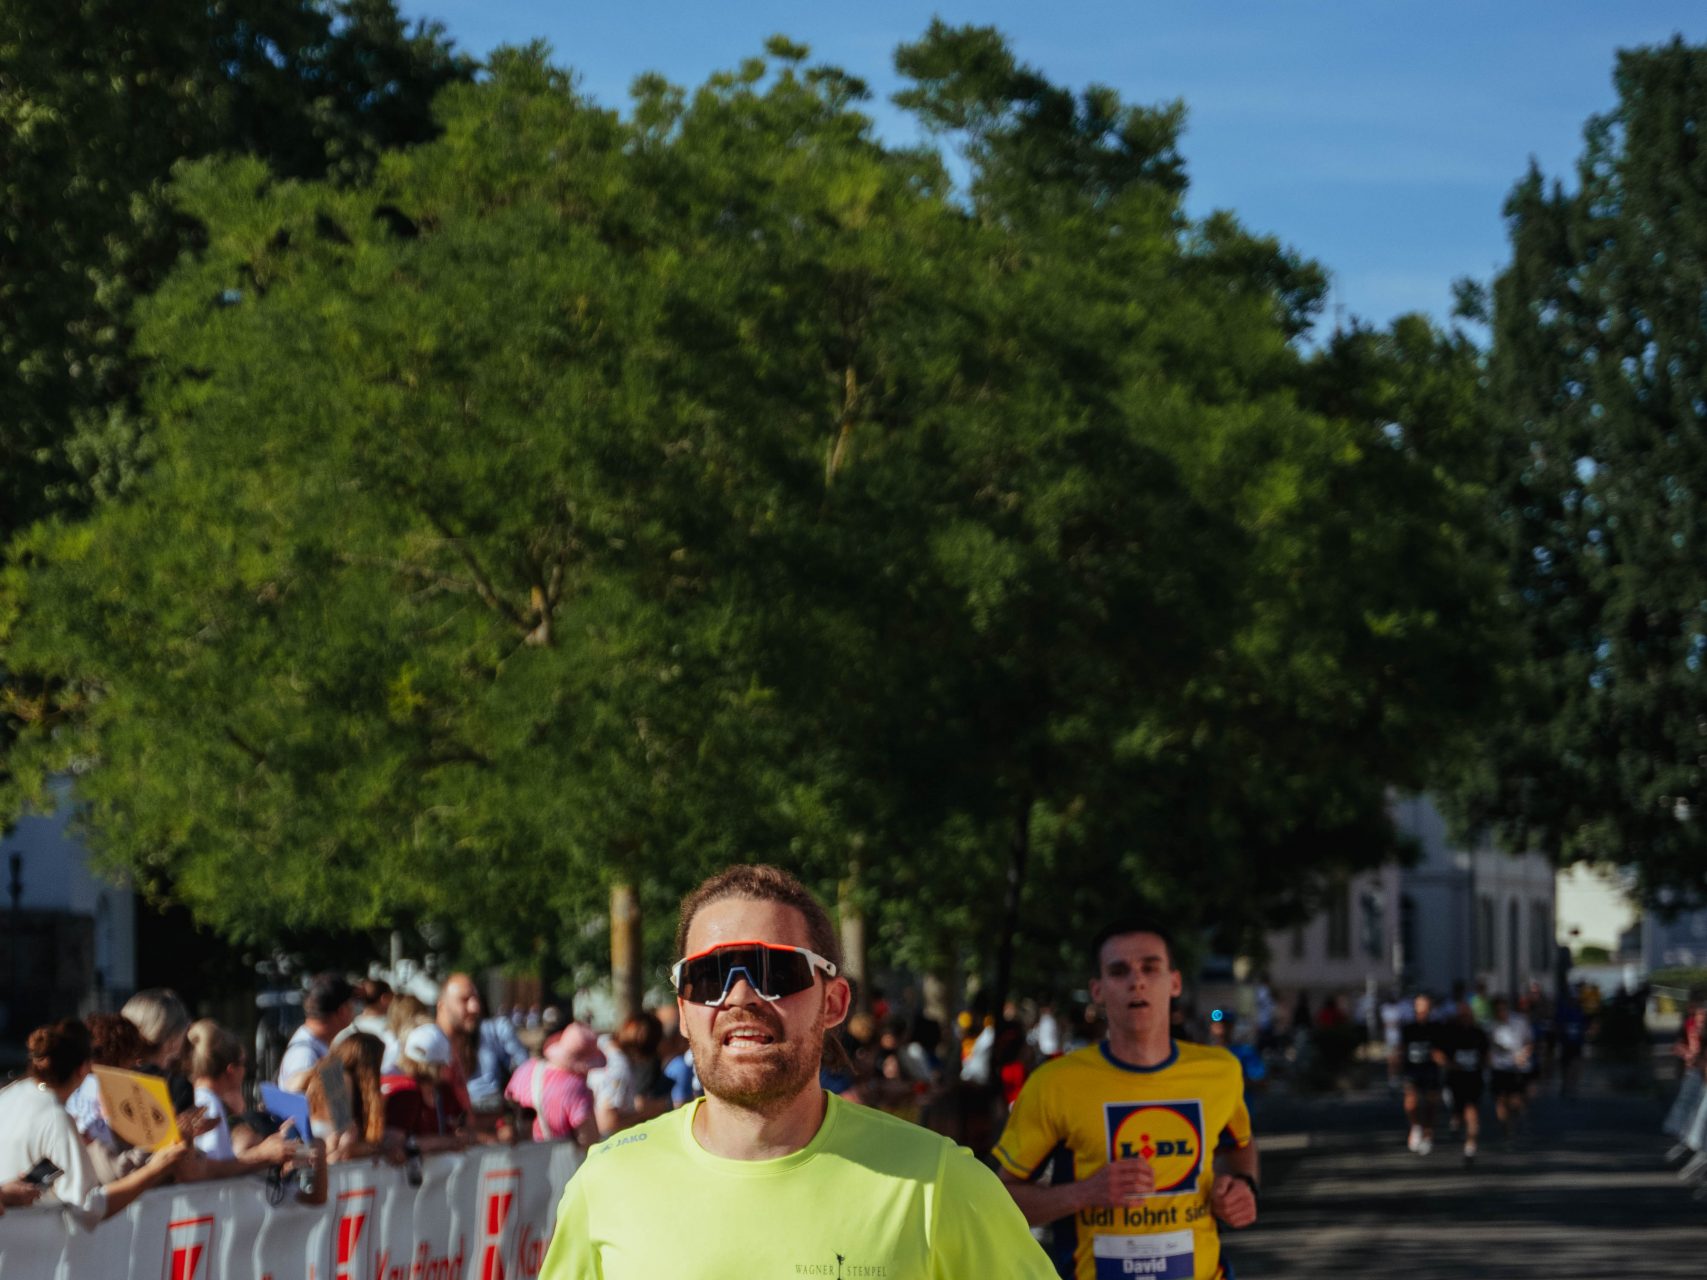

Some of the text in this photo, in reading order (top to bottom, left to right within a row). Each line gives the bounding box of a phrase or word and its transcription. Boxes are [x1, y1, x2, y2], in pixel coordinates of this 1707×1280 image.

[616, 1133, 648, 1147] JAKO
[1124, 1206, 1177, 1226] lohnt
[795, 1264, 887, 1277] WAGNER STEMPEL
[1123, 1257, 1167, 1273] David
